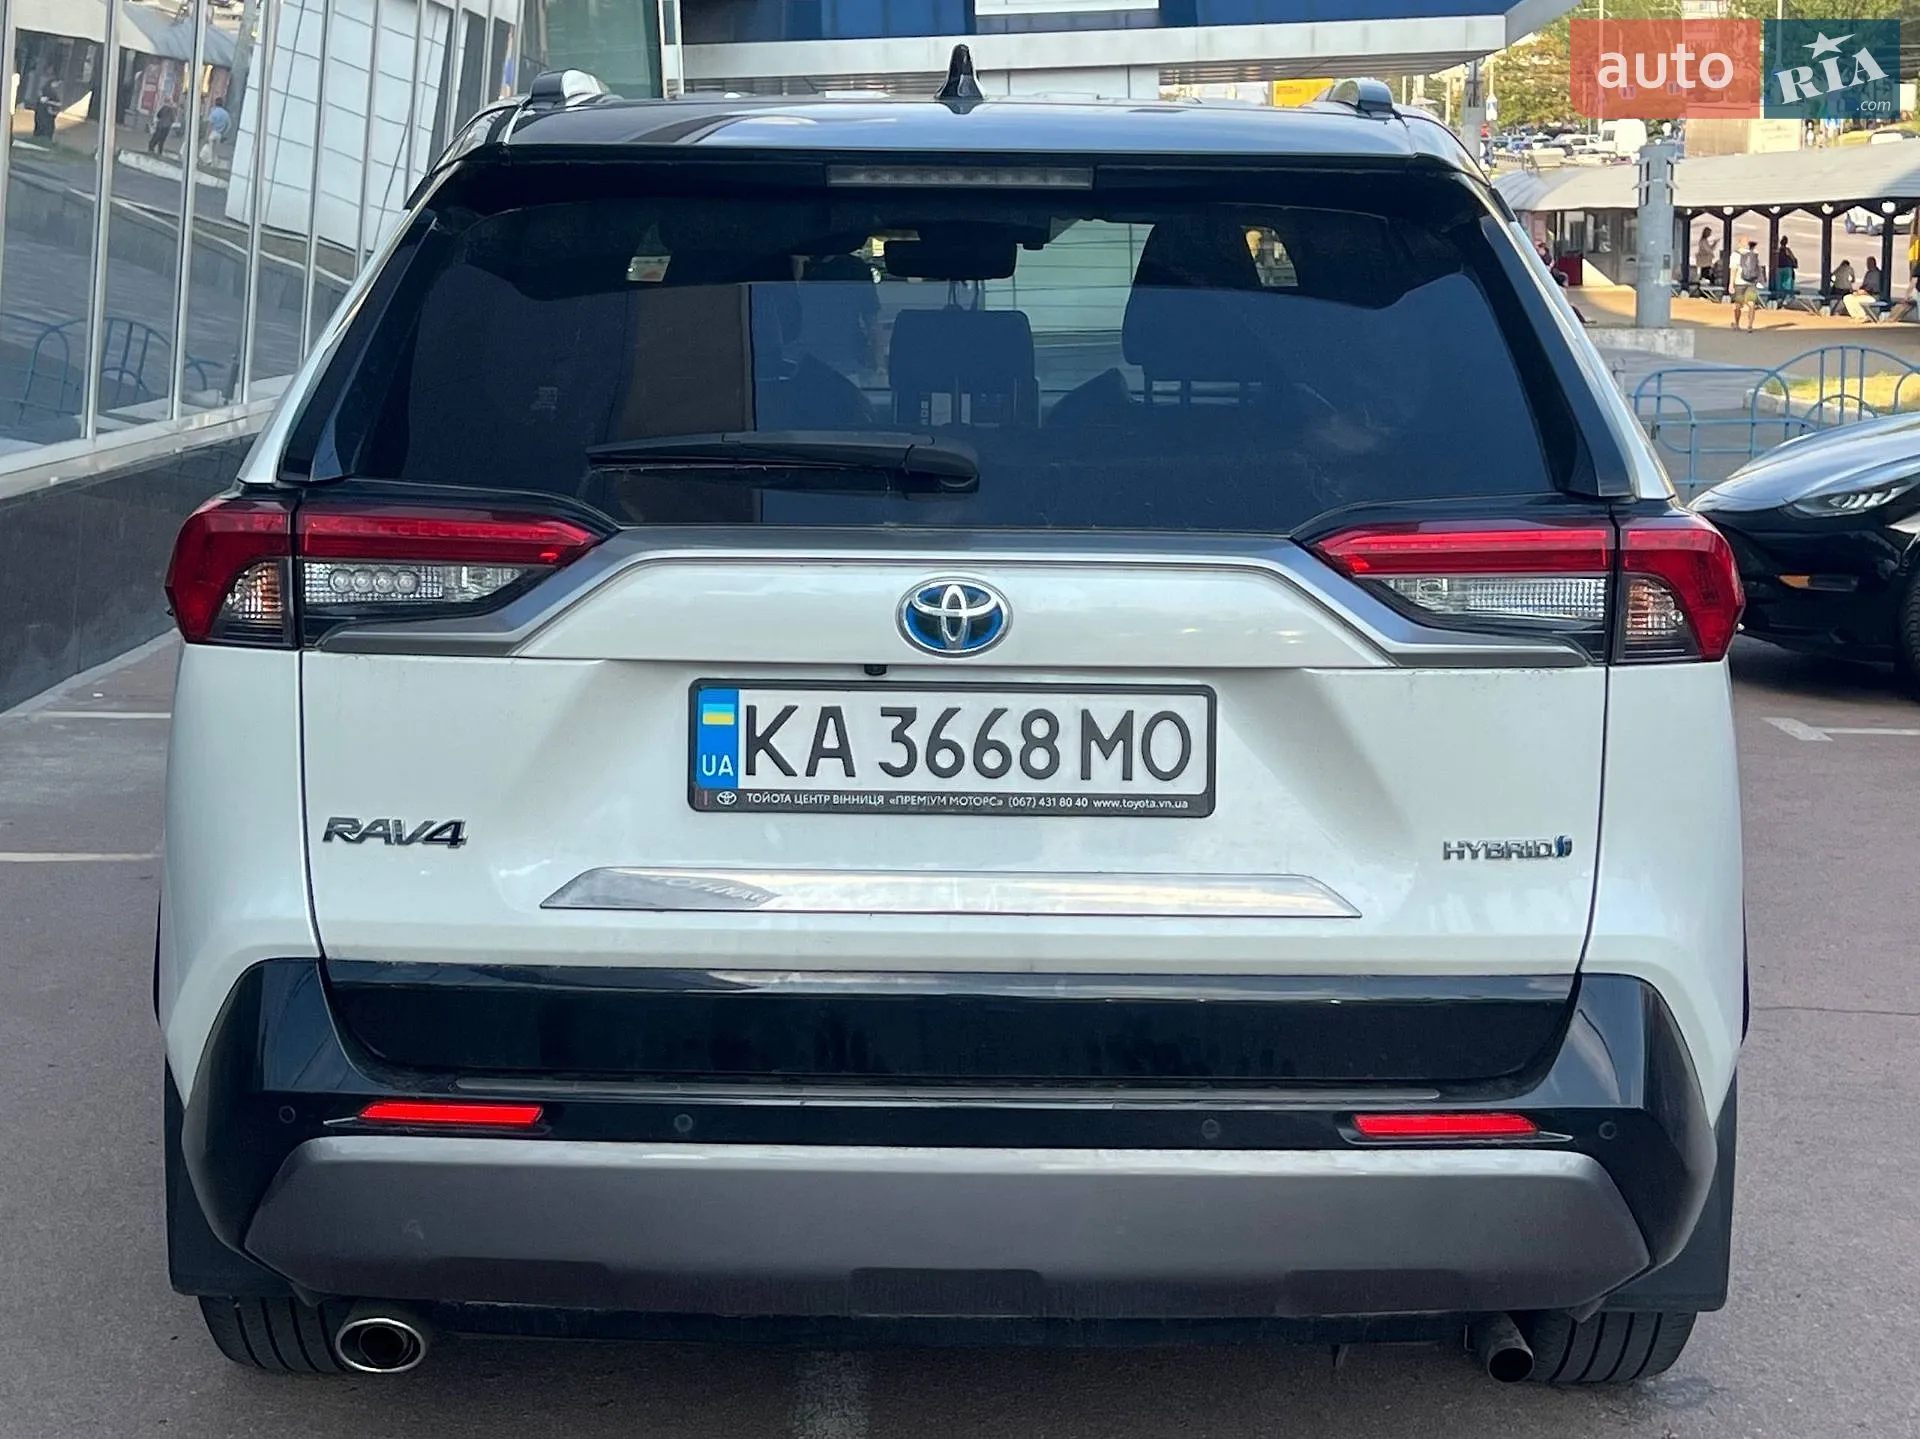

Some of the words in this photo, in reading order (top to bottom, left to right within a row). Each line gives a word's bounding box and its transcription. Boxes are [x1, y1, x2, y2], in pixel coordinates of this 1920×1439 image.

[745, 705, 857, 778] KA
[878, 706, 1060, 780] 3668
[1080, 709, 1191, 782] MO
[702, 755, 734, 777] UA
[746, 792, 792, 804] ТОЙОТА
[794, 793, 831, 805] ЦЕНТР
[832, 794, 885, 807] ВІННИЦЯ
[1008, 797, 1037, 809] (067)
[1038, 797, 1057, 808] 431
[1059, 797, 1073, 808] 80
[1075, 797, 1089, 808] 40
[1092, 798, 1189, 810] www.toyota.vn.ua
[322, 816, 469, 850] RAV4
[1443, 838, 1556, 861] HYBRID
